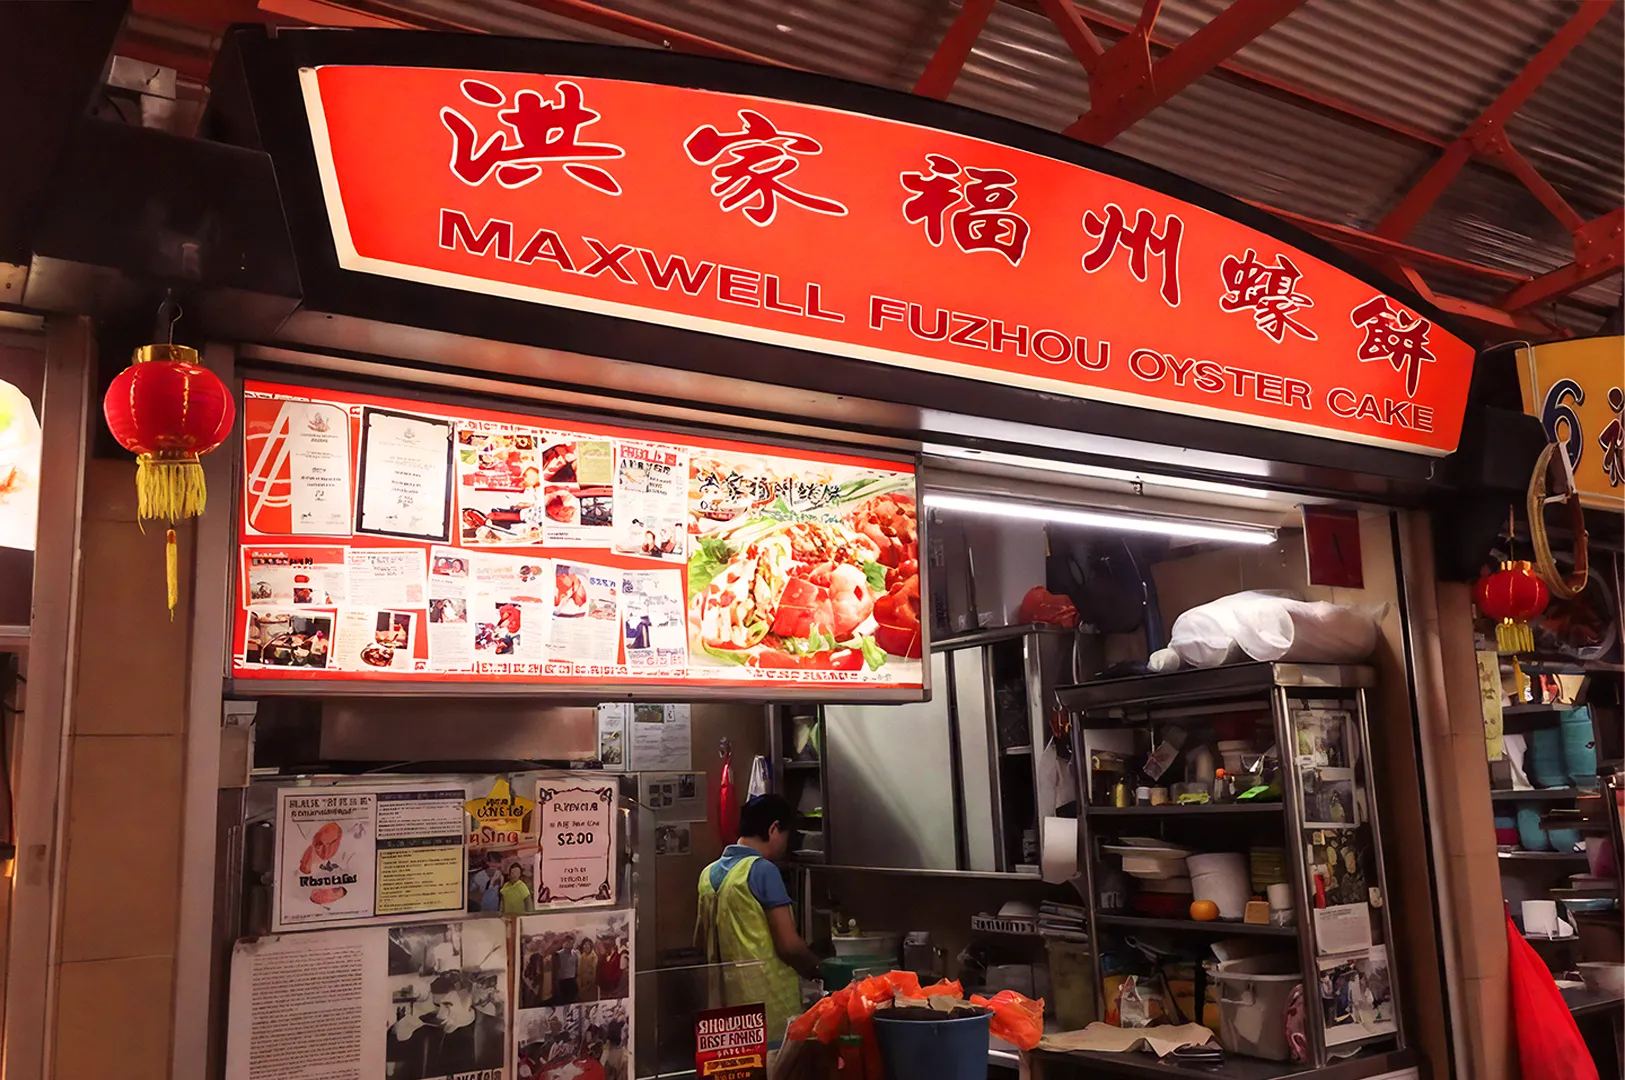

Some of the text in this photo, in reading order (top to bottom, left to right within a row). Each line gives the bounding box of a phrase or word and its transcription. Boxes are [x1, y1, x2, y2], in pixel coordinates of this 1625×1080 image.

[439, 207, 1434, 432] MAXWELL FUZHOU OYSTER CAKE
[1541, 378, 1585, 475] 6
